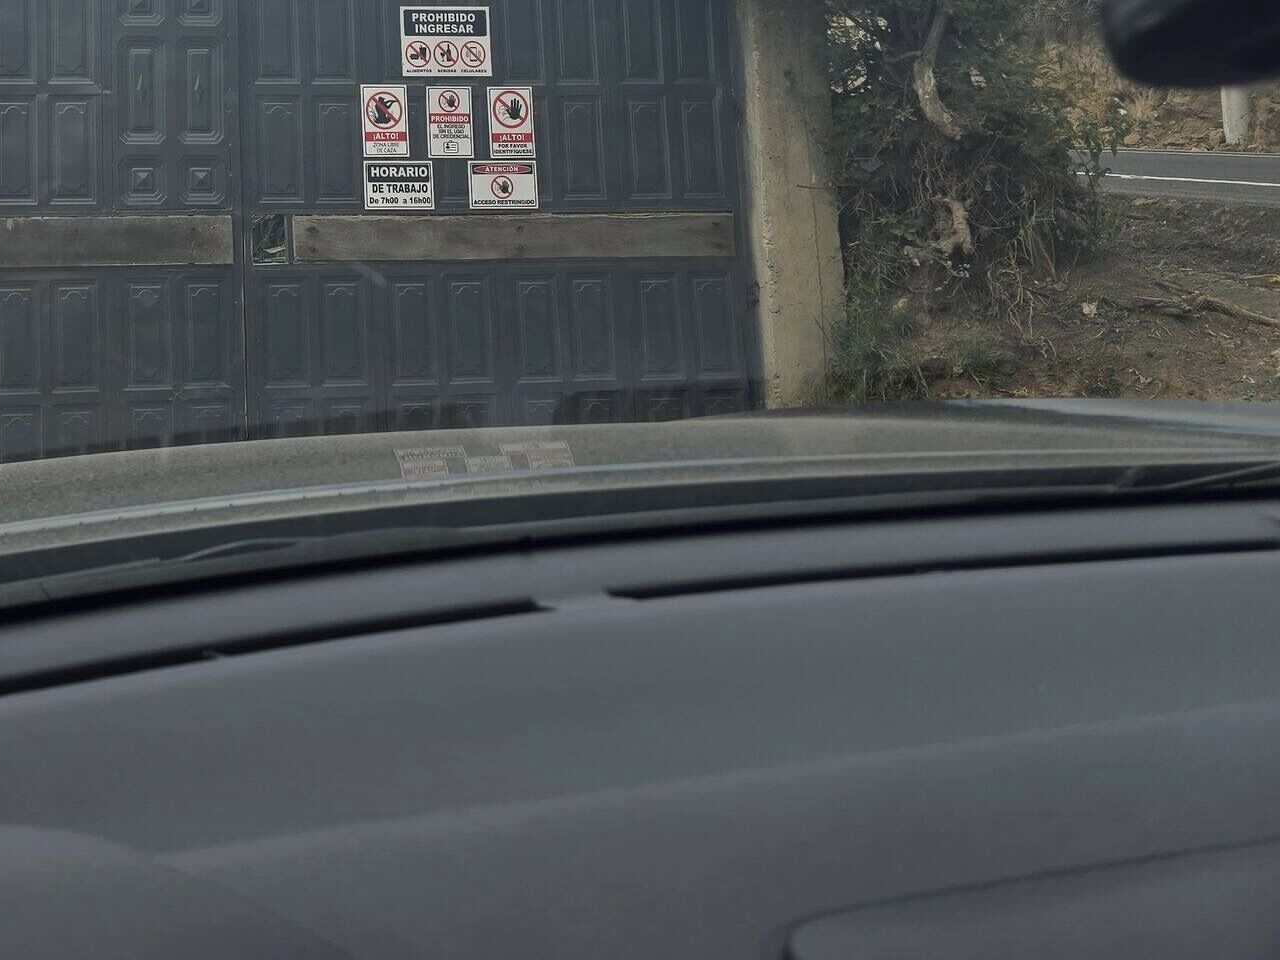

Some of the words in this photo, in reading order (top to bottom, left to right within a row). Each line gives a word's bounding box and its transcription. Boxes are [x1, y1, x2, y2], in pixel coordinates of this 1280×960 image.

[412, 13, 476, 22] PROHIBIDO
[415, 24, 474, 33] INGRESAR
[373, 133, 399, 141] ¡ALTO!
[500, 134, 525, 142] ¡ALTO!
[370, 167, 428, 177] HORARIO
[372, 184, 384, 193] DE
[386, 184, 428, 193] TRABAJO
